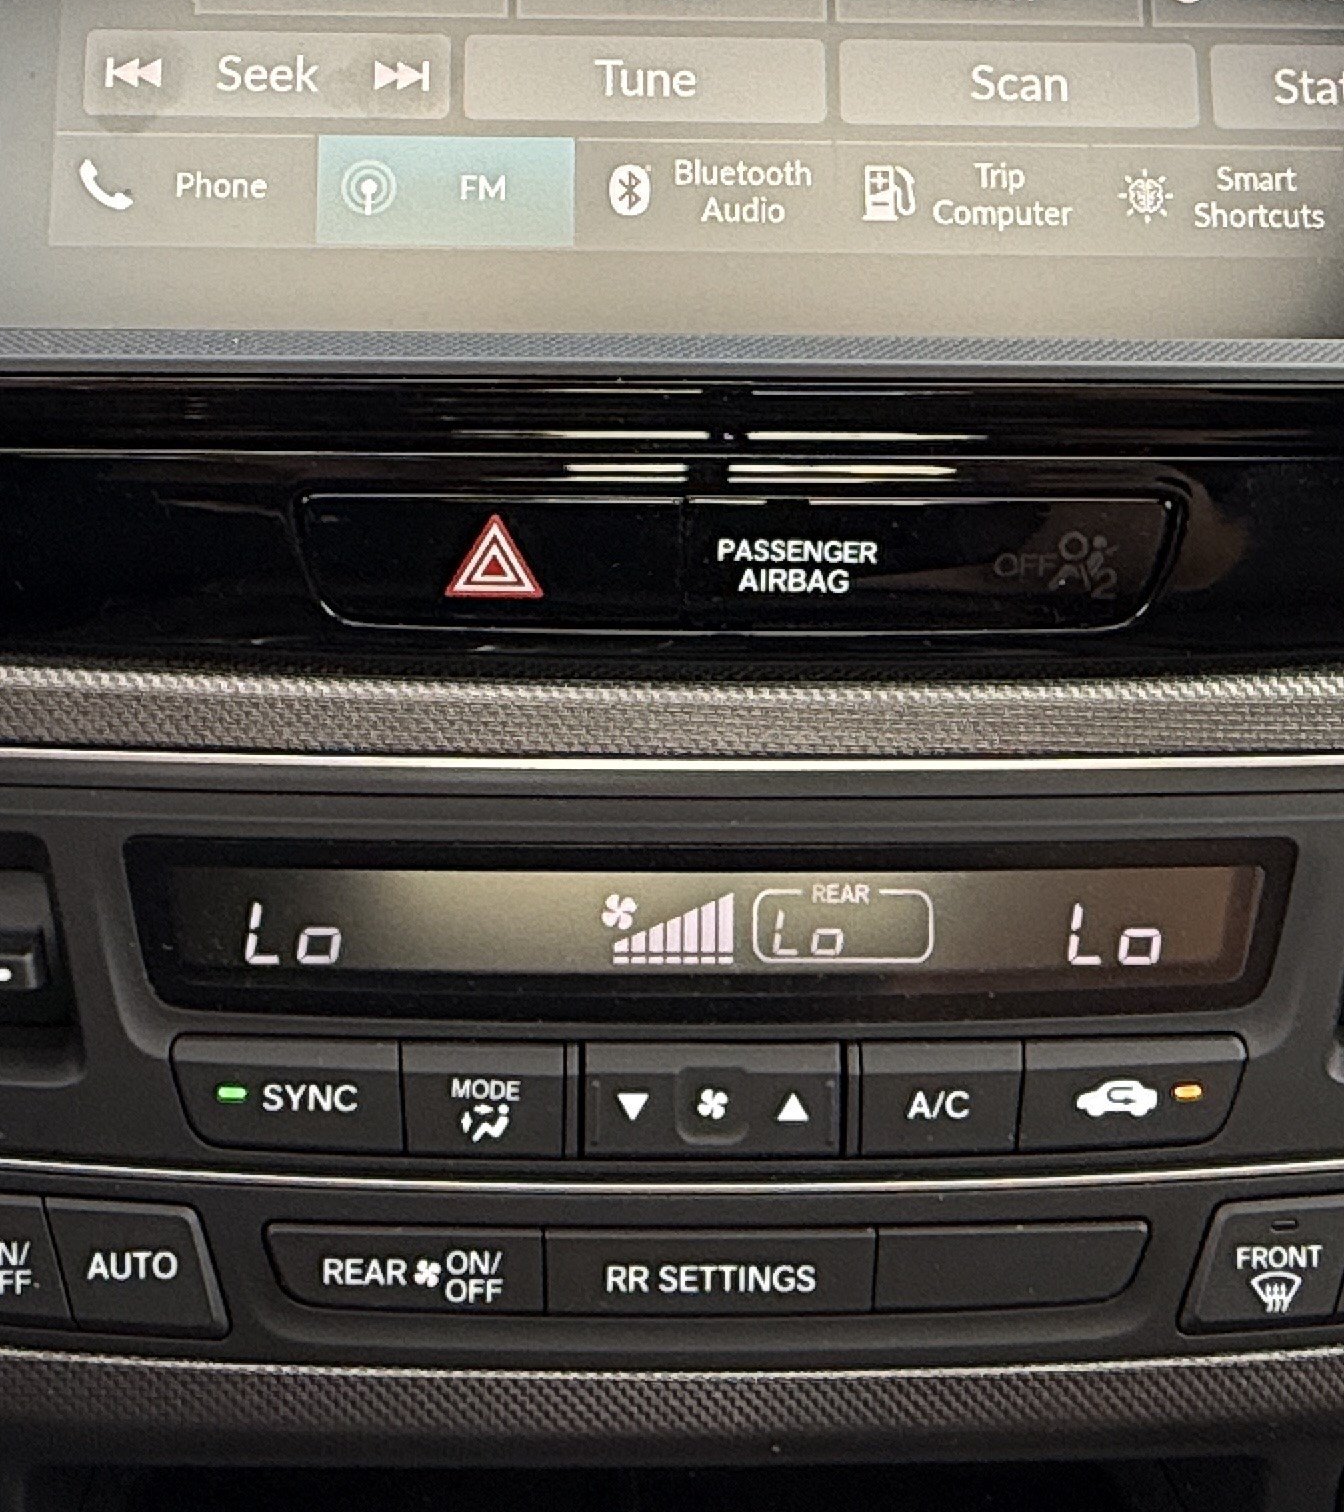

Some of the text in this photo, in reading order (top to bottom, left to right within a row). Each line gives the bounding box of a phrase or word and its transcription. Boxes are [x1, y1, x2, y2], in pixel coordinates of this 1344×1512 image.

[216, 54, 320, 93] Seek
[594, 58, 698, 98] Tune
[970, 64, 1068, 102] Scan
[176, 170, 268, 199] Phone
[674, 158, 812, 187] Bluetooth
[972, 161, 1026, 196] Trip
[1216, 166, 1298, 192] Smart
[460, 174, 506, 202] FM
[700, 195, 786, 224] Audio
[932, 198, 1074, 232] Computer
[1194, 200, 1326, 230] Shortcuts
[716, 539, 878, 564] PASSENGER
[994, 553, 1057, 577] OFF
[738, 569, 850, 594] AIRBAG
[812, 882, 871, 905] REAR
[244, 902, 342, 965] Lo
[772, 909, 844, 956] Lo
[1067, 902, 1162, 966] Lo
[262, 1084, 358, 1112] SYNC
[450, 1078, 522, 1102] MODE
[906, 1090, 970, 1120] A/C
[86, 1250, 178, 1281] AUTO
[446, 1250, 504, 1276] ON/
[1236, 1245, 1324, 1269] FRONT
[322, 1258, 408, 1286] REAR
[606, 1264, 816, 1293] RR SETTINGS
[444, 1278, 504, 1304] OFF
